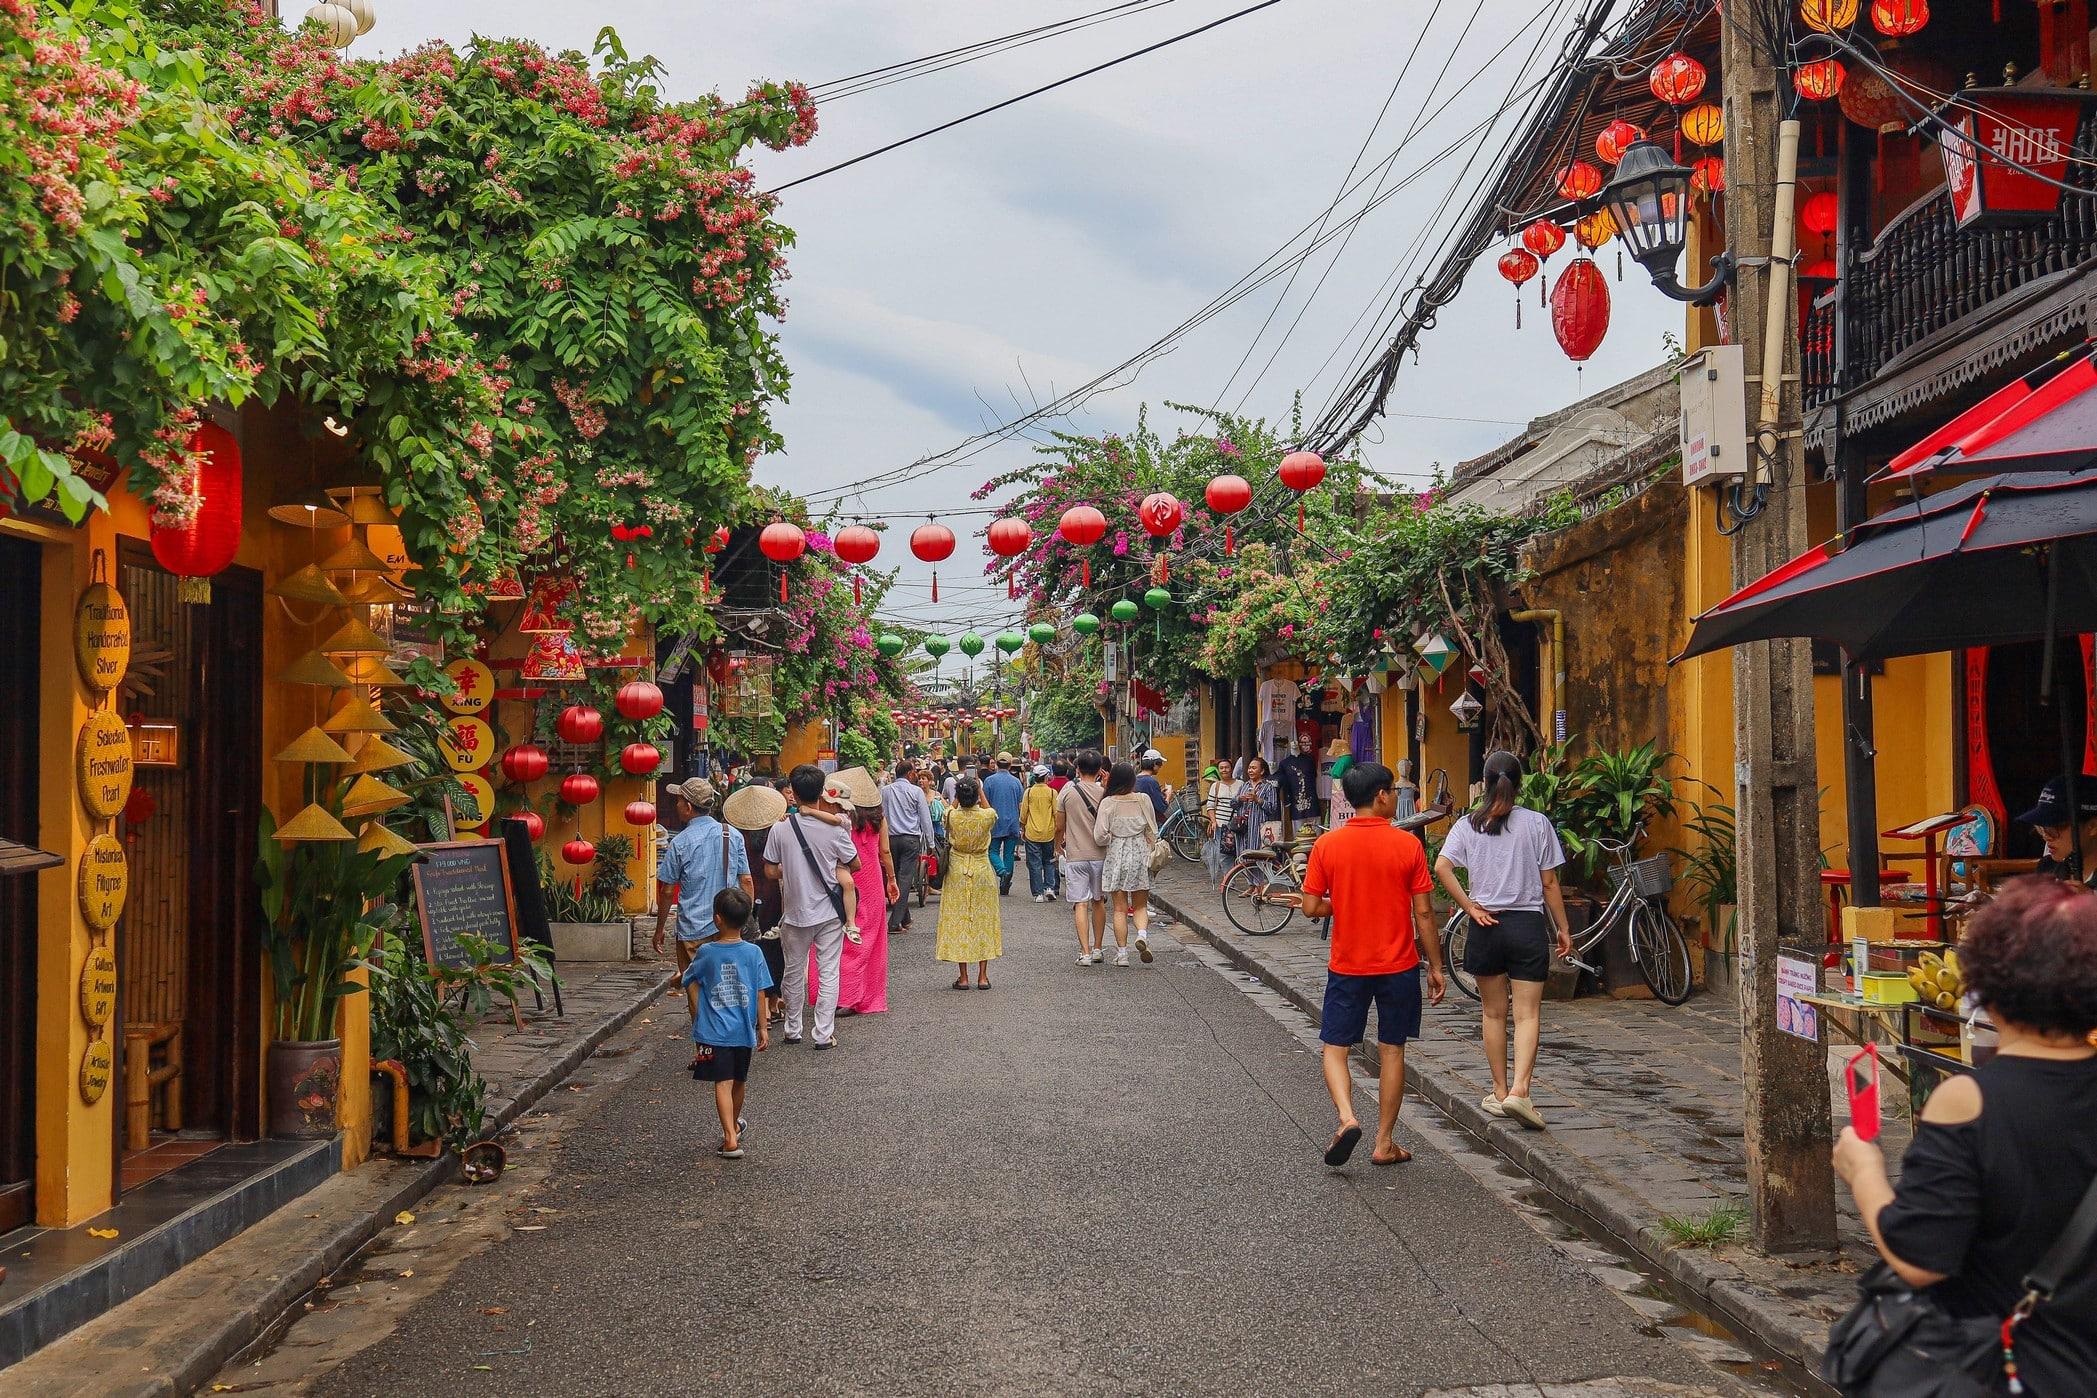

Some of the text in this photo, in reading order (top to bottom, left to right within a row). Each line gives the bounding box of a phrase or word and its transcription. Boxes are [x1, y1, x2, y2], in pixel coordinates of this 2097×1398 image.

[96, 657, 118, 675] Silver
[454, 666, 480, 696] 幸
[97, 728, 126, 747] Selected
[90, 755, 130, 777] Freshwater
[457, 754, 474, 764] FU
[102, 784, 120, 803] Pearl
[101, 902, 112, 918] Art
